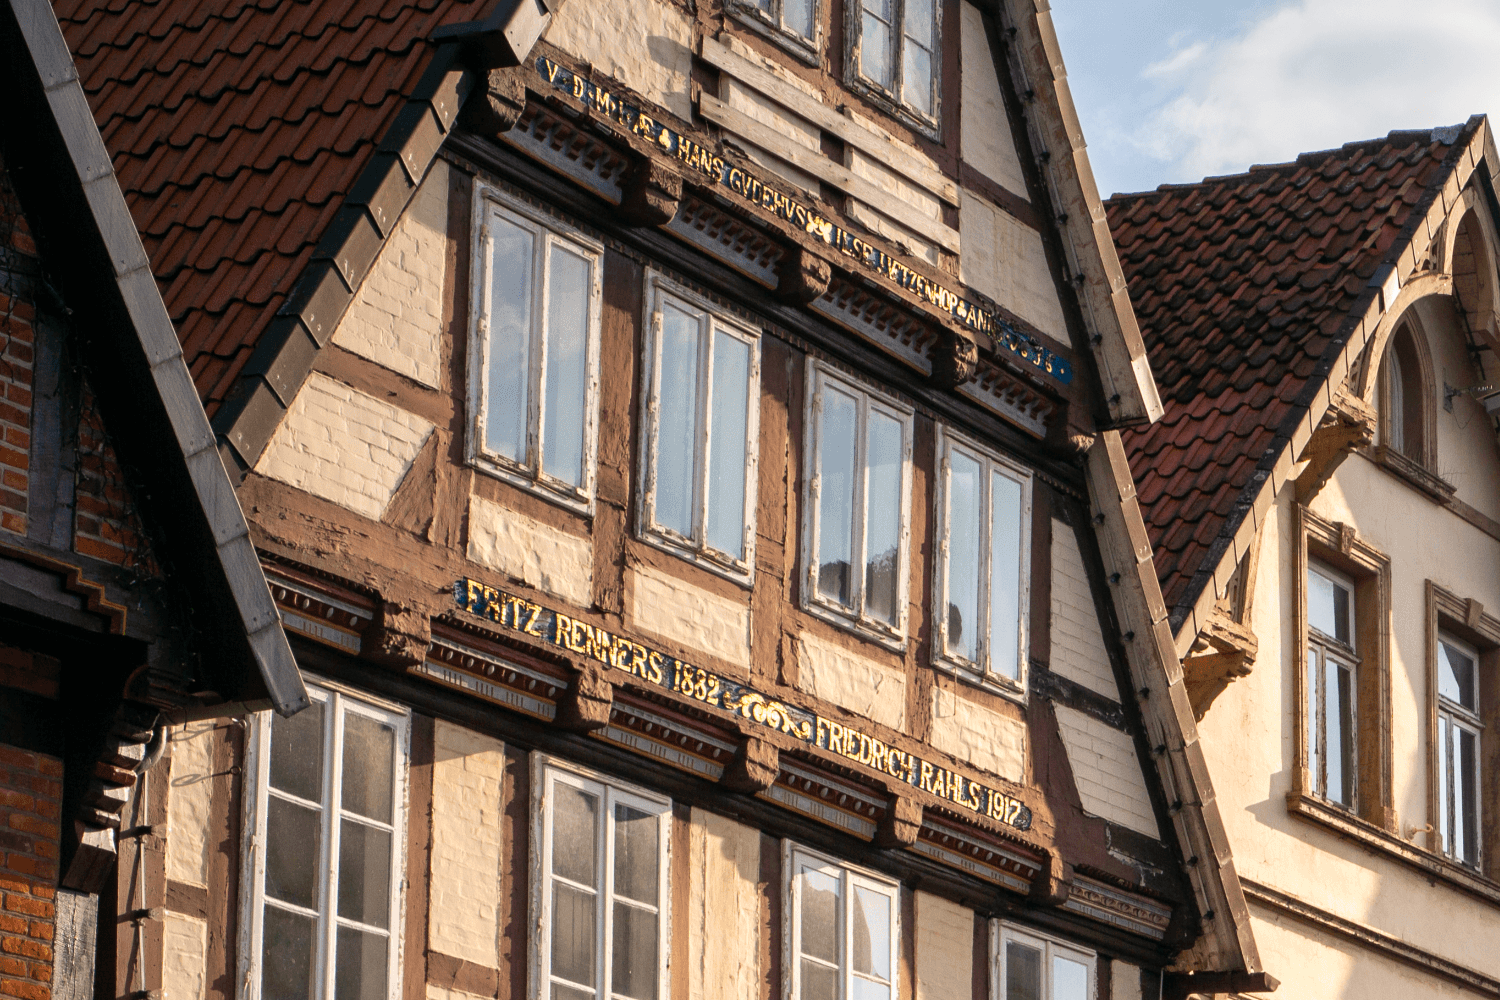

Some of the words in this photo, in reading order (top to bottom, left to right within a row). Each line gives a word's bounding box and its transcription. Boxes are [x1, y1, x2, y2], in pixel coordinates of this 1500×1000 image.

[677, 135, 724, 182] HANS
[466, 578, 543, 637] FRITZ
[555, 612, 664, 685] RENNERS
[673, 659, 720, 706] 1882
[815, 715, 914, 784] FRIEDRICH
[919, 759, 981, 812] RAHLS
[986, 788, 1022, 825] 1917
